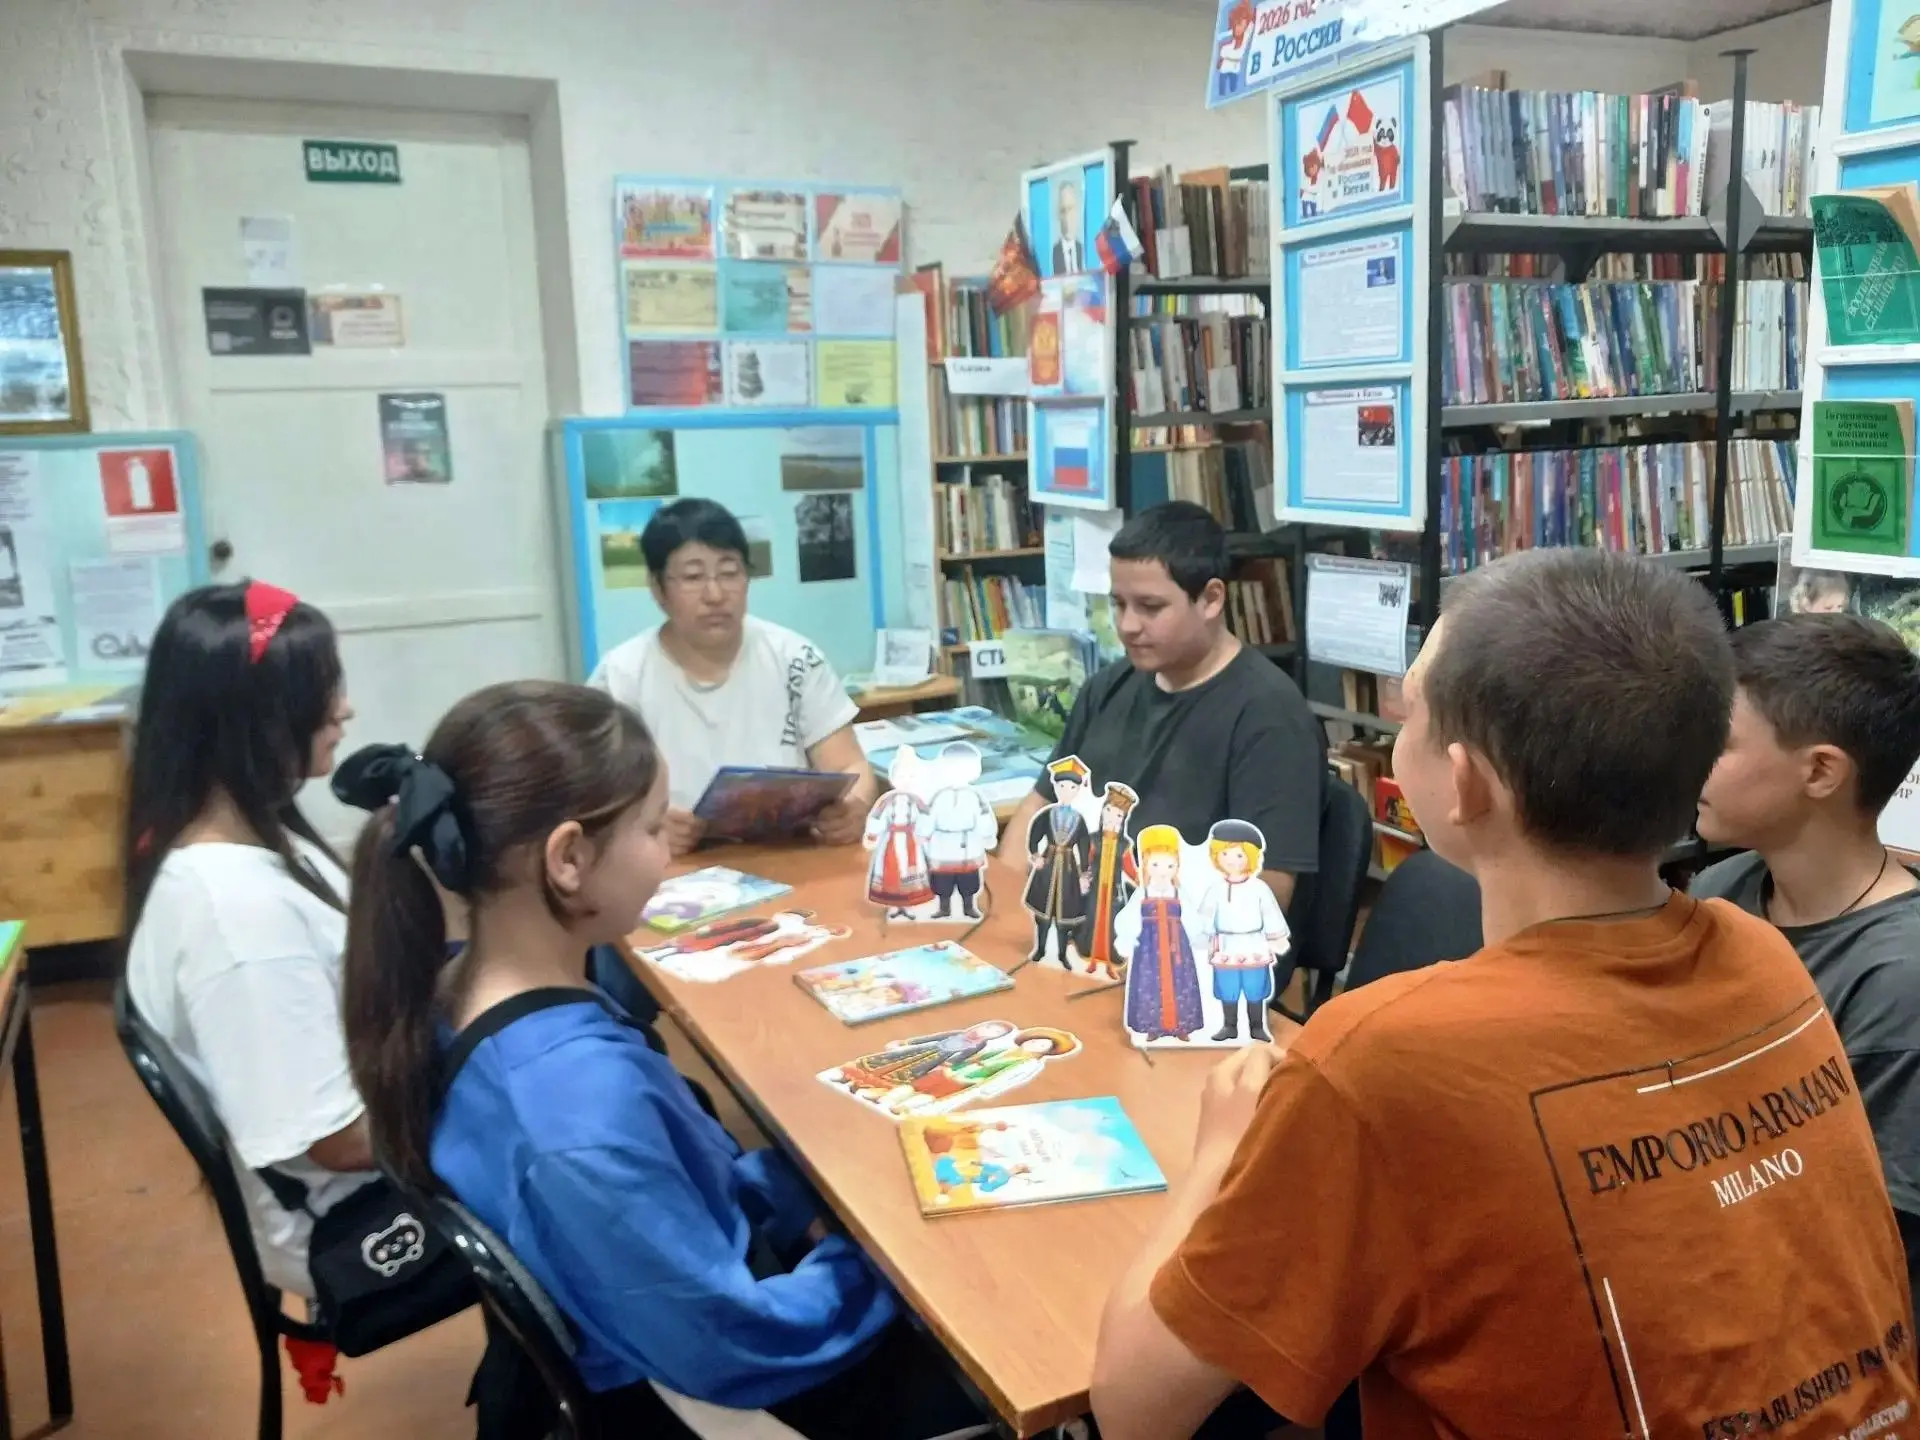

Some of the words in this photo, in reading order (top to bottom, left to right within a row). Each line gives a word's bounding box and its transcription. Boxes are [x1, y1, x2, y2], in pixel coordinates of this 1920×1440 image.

[1250, 51, 1261, 76] в
[1272, 17, 1344, 67] России
[1258, 2, 1290, 35] 2026
[309, 147, 397, 177] ВЫХОД
[1577, 1112, 1747, 1195] EMPORIO
[1747, 1056, 1850, 1146] ARMAN
[1710, 1148, 1804, 1208] MILANO
